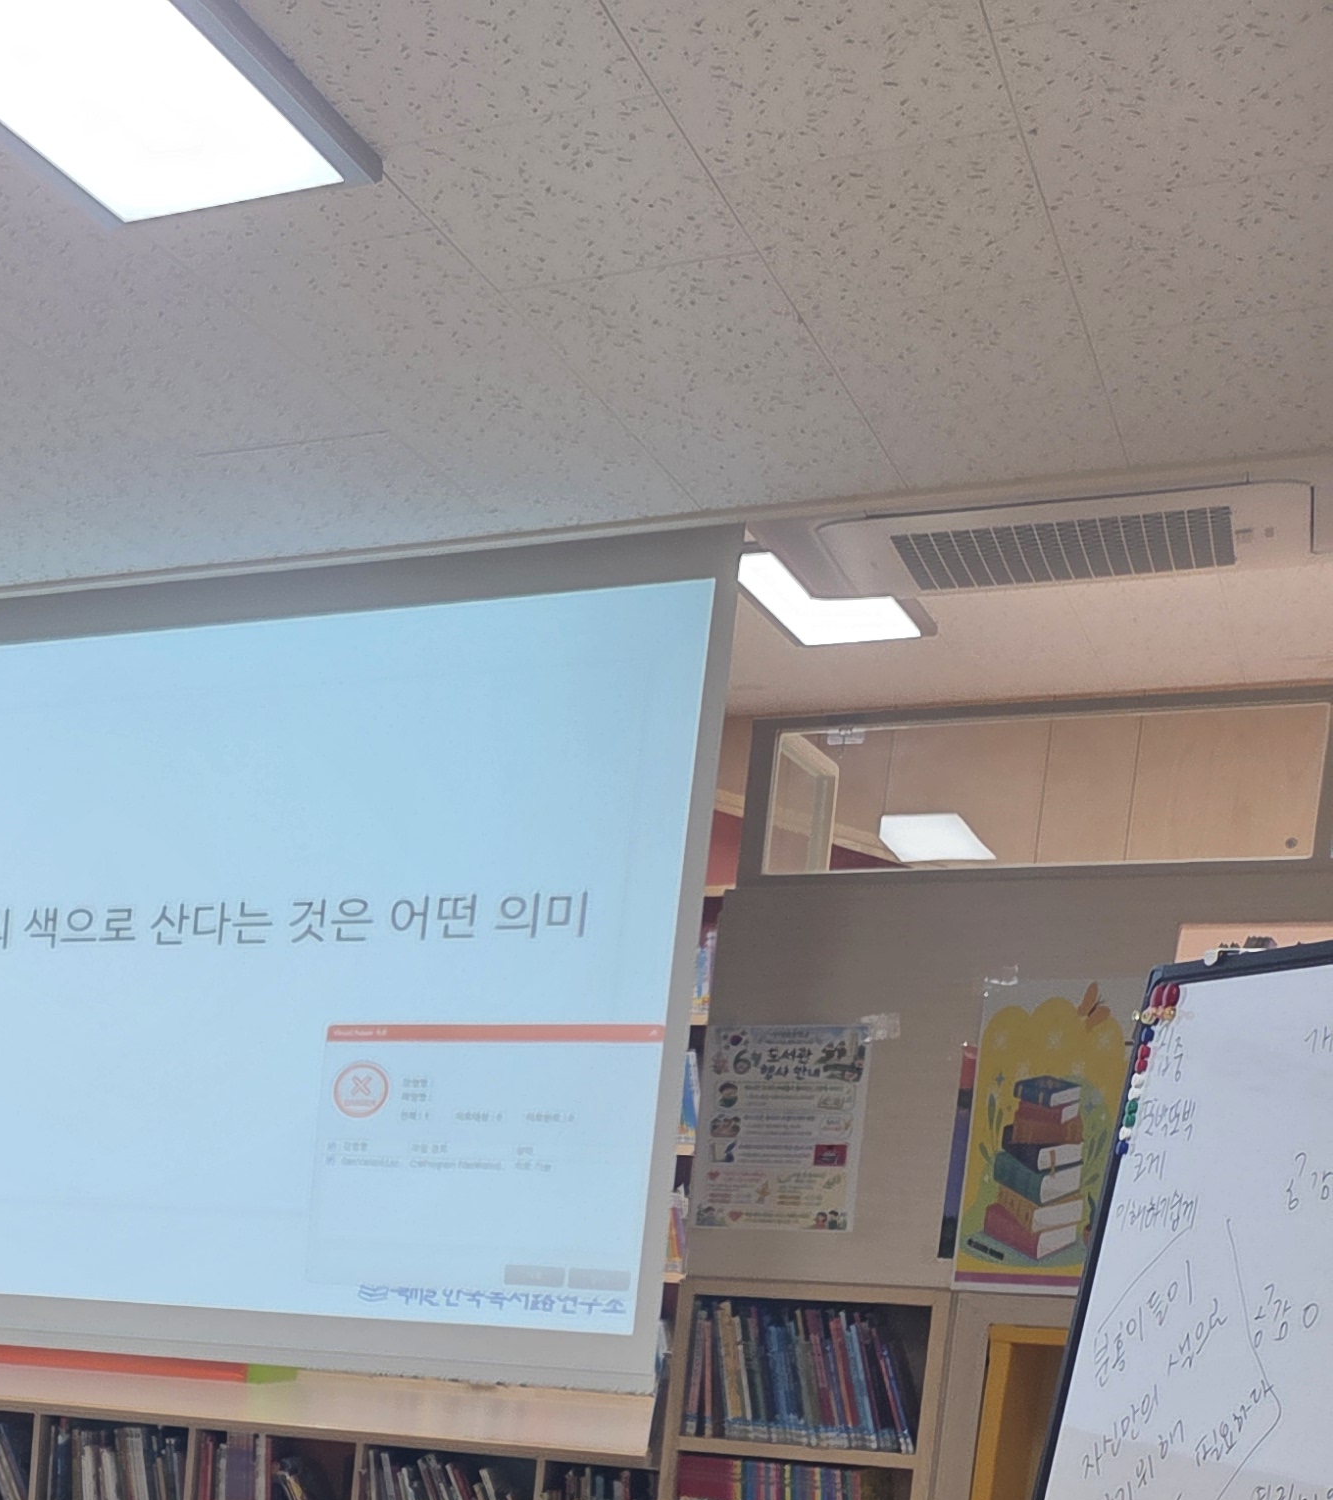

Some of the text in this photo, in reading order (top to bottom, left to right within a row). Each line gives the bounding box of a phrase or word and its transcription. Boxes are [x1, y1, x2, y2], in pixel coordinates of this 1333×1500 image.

[23, 906, 137, 950] 색으로
[150, 900, 274, 946] 산다는
[288, 897, 375, 944] 것은
[390, 893, 478, 942] 어떤
[494, 889, 589, 939] 의미
